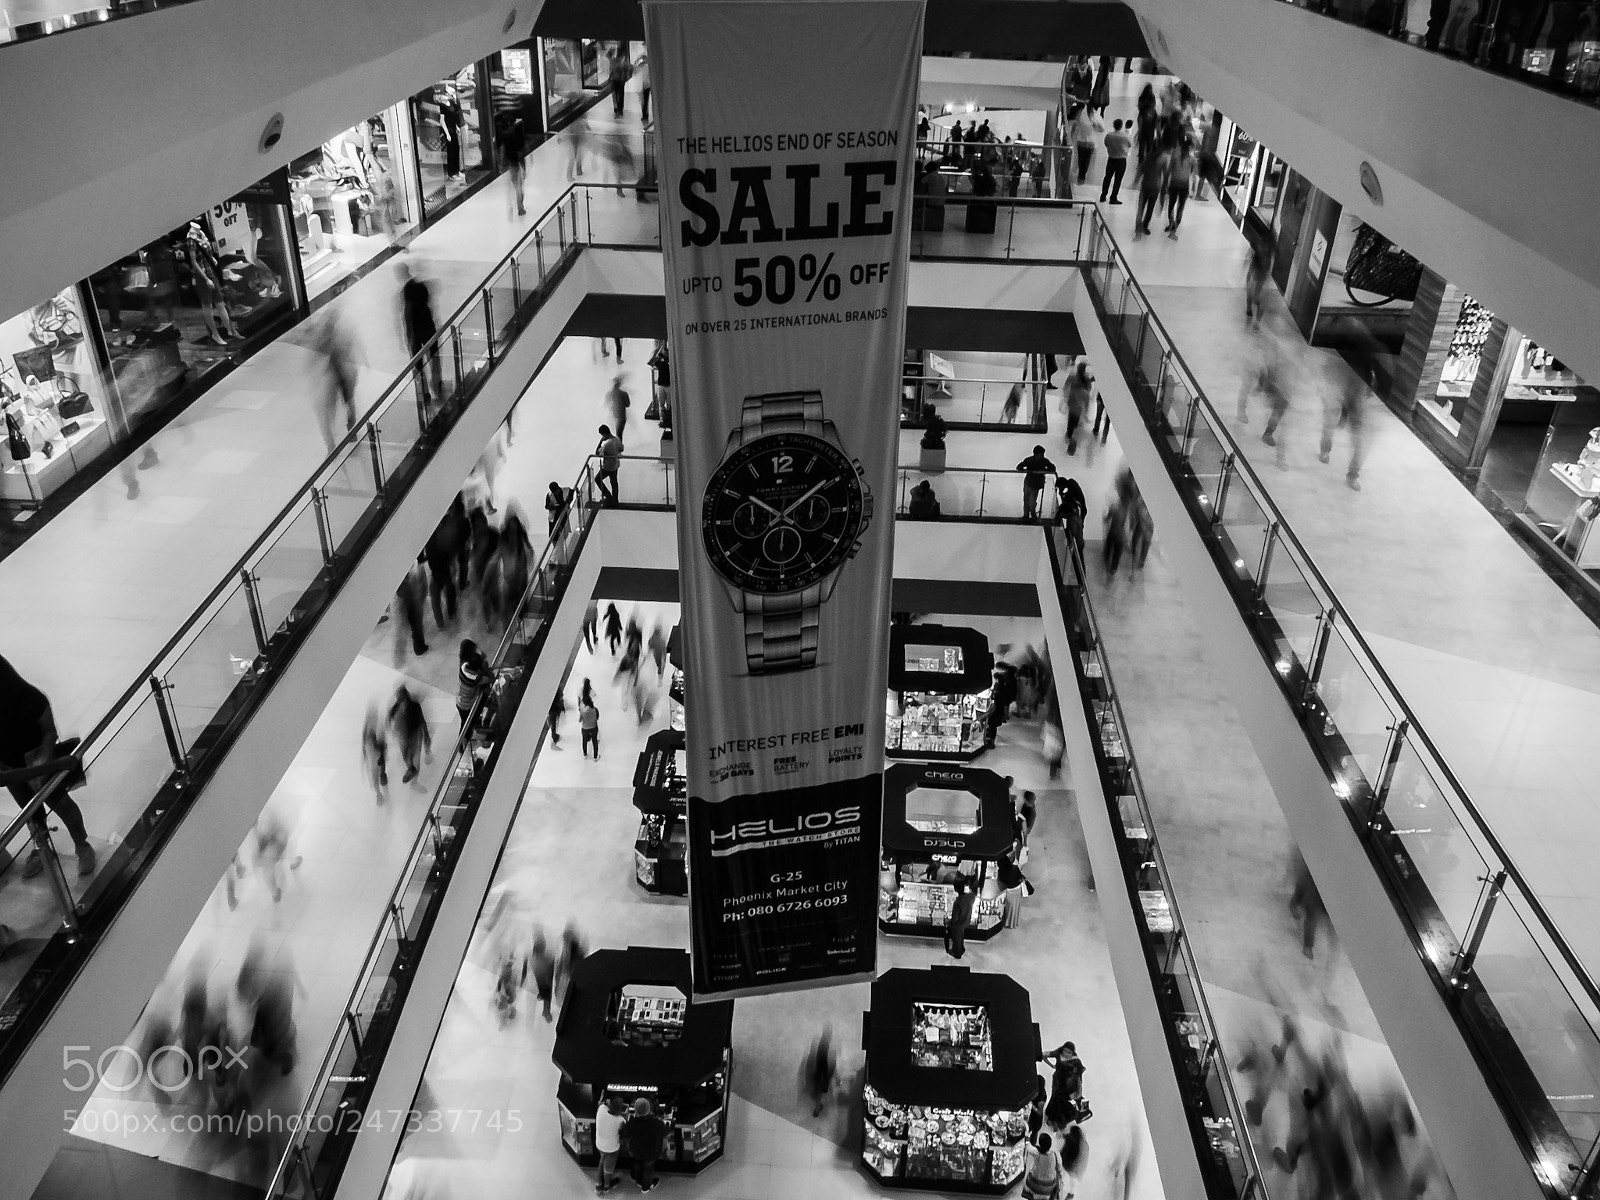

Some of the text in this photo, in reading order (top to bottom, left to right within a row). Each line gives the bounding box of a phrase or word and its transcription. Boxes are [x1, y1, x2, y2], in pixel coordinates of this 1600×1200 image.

[677, 130, 898, 154] THE HELIOS END OF SEASON
[679, 160, 897, 248] SALE
[734, 252, 841, 307] 50%
[850, 262, 890, 285] OFF
[685, 307, 888, 335] ON OVER 25 INTERNATIONAL BRANDS
[771, 455, 793, 474] 12
[709, 723, 864, 760] INTEREST FREE EMI
[828, 746, 863, 757] LOYALTY
[773, 755, 797, 765] FREE
[773, 761, 810, 772] BATTERY
[828, 753, 863, 764] POINTS
[731, 768, 754, 778] DAYS
[710, 805, 861, 844] HELIOS
[835, 836, 861, 846] TITAN
[770, 871, 803, 883] G-25
[723, 880, 848, 908] Phoenix Market City
[723, 894, 848, 923] Ph: 080 6726 6093
